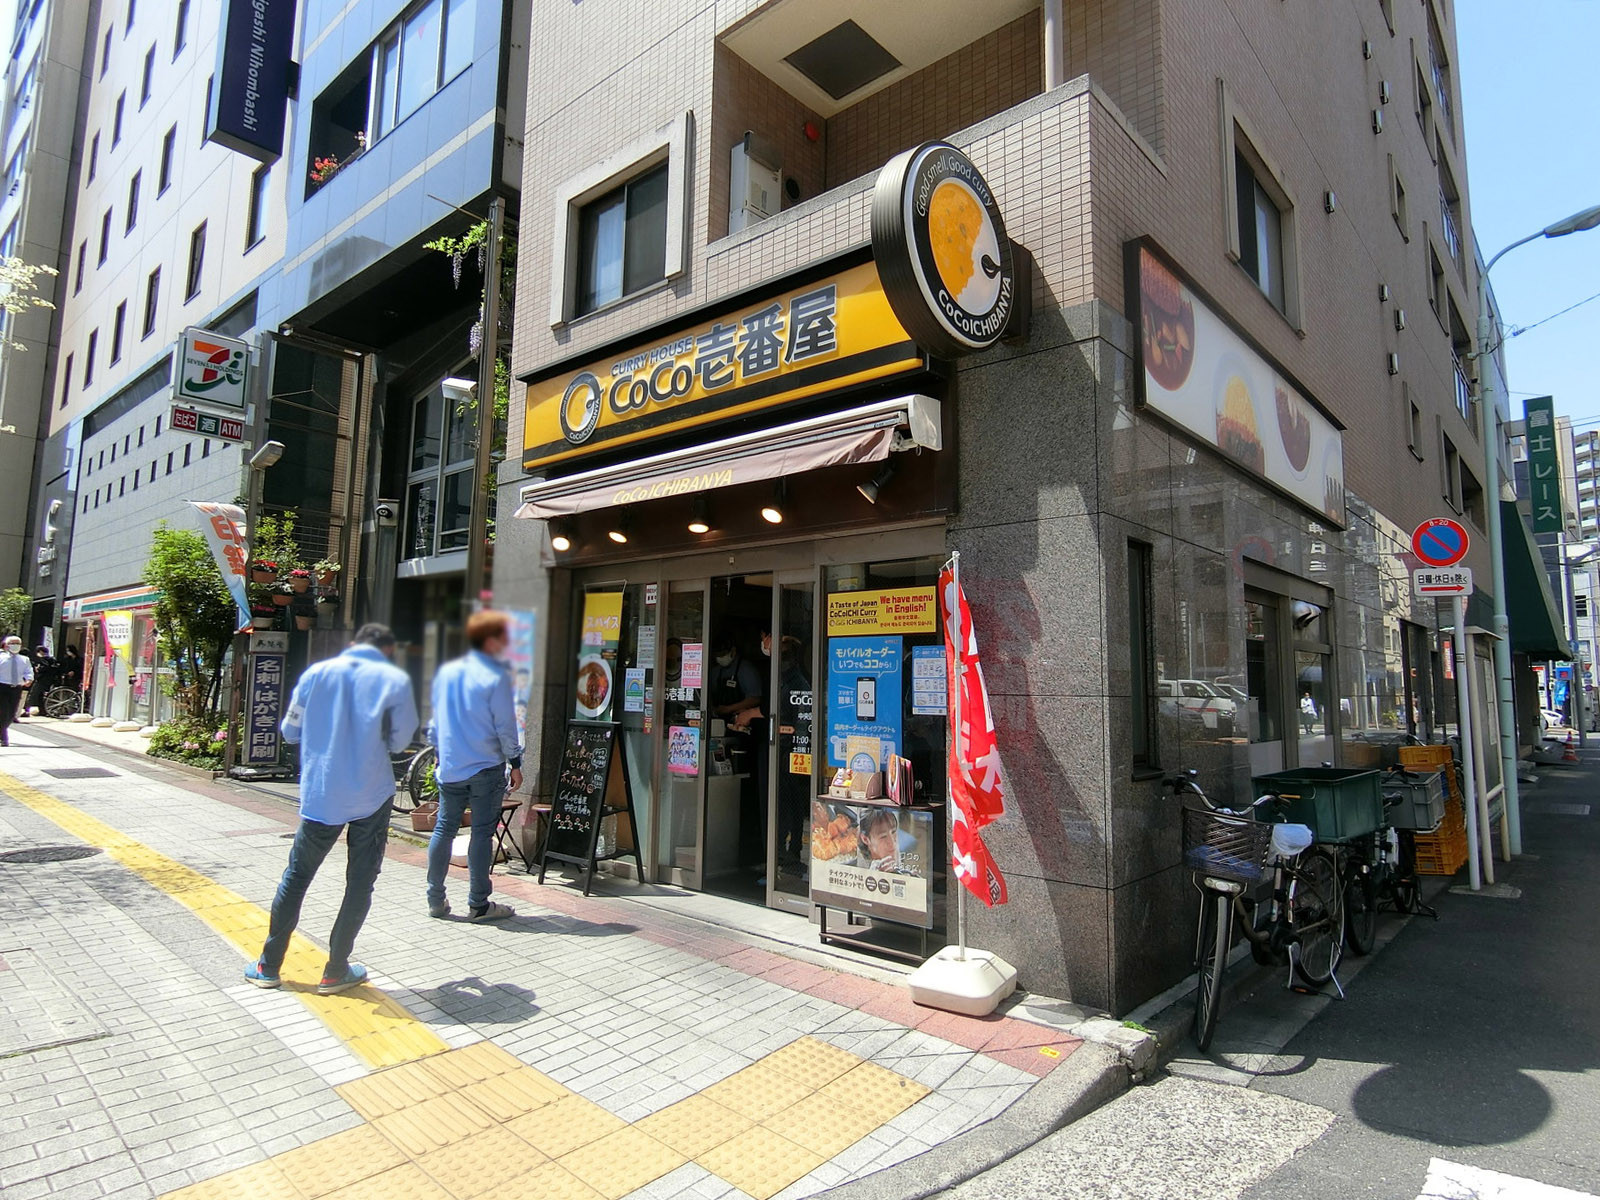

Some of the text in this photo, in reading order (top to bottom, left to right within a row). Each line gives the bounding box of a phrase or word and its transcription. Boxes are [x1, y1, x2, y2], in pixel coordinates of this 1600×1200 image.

[243, 43, 265, 132] Nihombashi
[917, 173, 931, 218] Good
[948, 156, 971, 179] Good
[970, 175, 993, 207] curry
[938, 276, 1011, 336] CoCoICHIBANYA
[609, 284, 837, 415] CoCo壱番屋
[610, 336, 695, 378] CURRY HOUSE
[174, 412, 241, 437] たばこ 酒 ATM
[1528, 409, 1557, 520] 富士レース
[860, 600, 877, 608] Japan
[880, 594, 933, 604] We have menu
[859, 609, 877, 618] Curry
[886, 603, 926, 614] in English!
[846, 618, 878, 626] ICHIBANYA
[836, 646, 896, 658] モバイルオーダー
[251, 659, 281, 758] 名刺・はがき・印刷
[792, 735, 809, 744] 11:00
[829, 869, 864, 881] テイクアウトは
